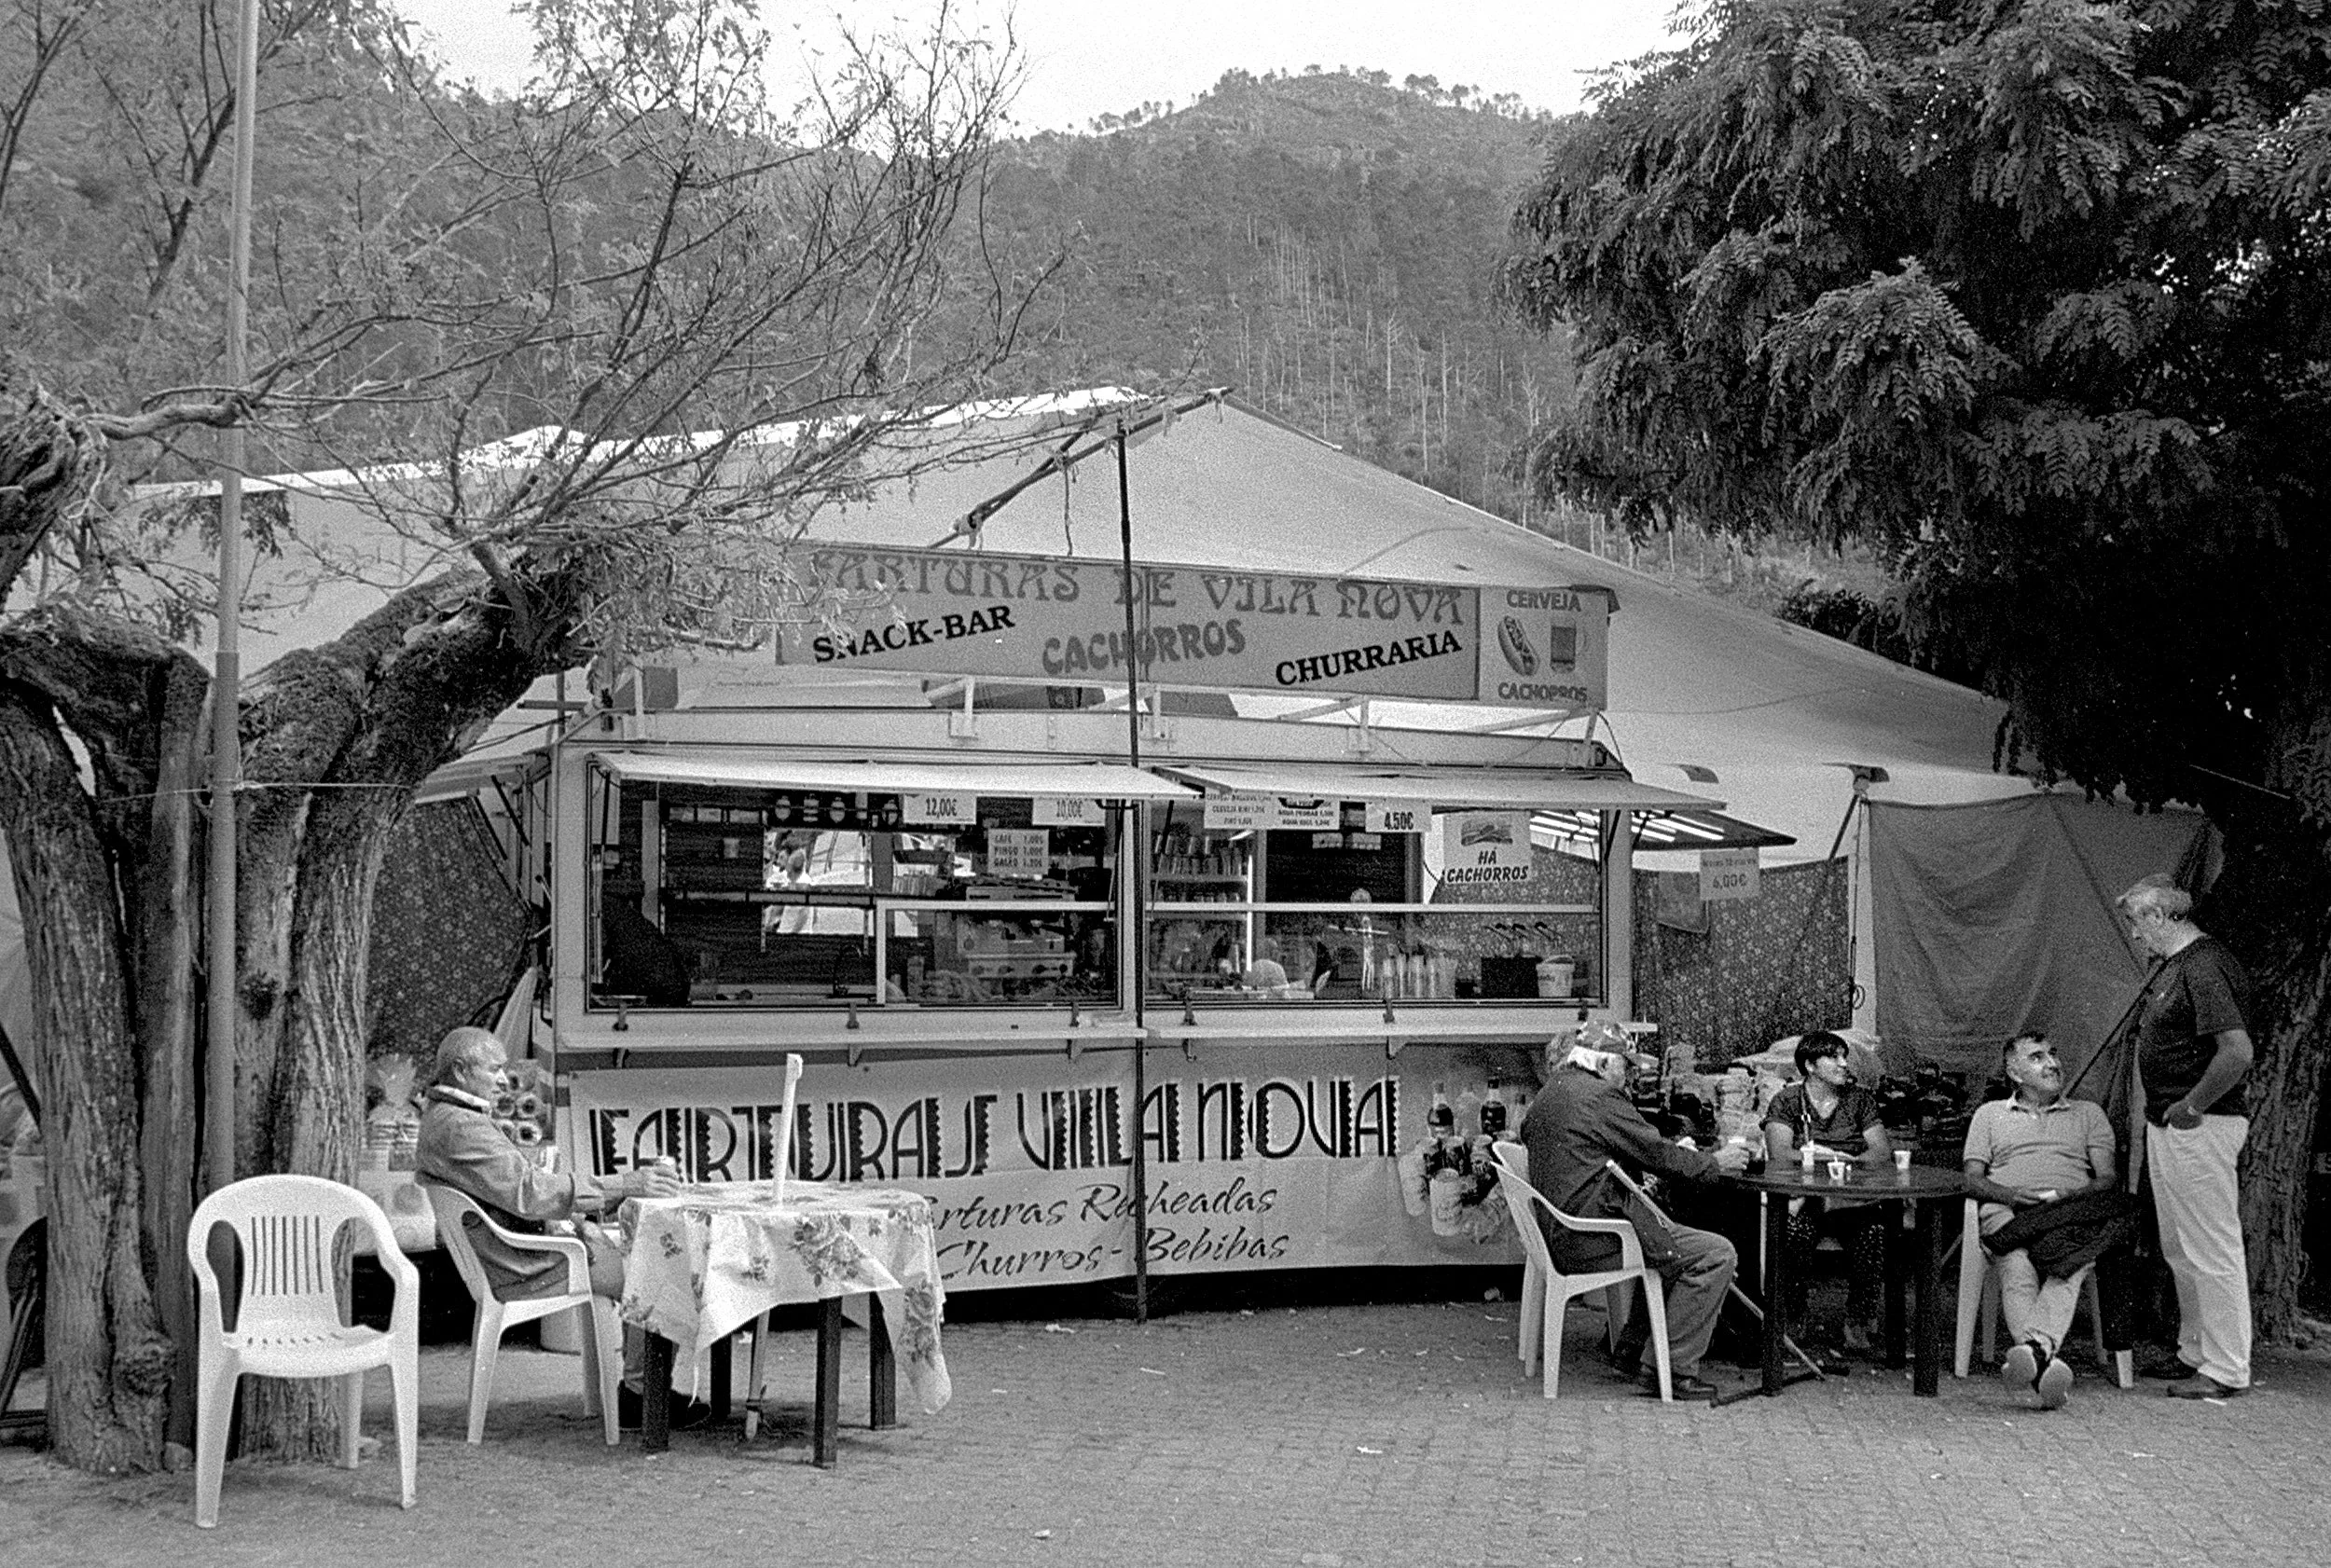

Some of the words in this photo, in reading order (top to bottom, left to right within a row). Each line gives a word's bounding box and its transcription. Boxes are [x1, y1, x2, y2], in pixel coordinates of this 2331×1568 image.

[1113, 567, 1177, 608] DE
[1200, 574, 1320, 616] VILA
[1336, 578, 1464, 626] NOVA
[1506, 589, 1582, 612] CERVEJA
[812, 604, 1016, 663] SNACK-BAR
[1041, 618, 1247, 675] CACHORROS
[1276, 629, 1463, 685] CHURRARIA
[926, 798, 958, 818] 12,00€
[1446, 865, 1529, 883] CACHORROS
[1478, 846, 1497, 865] HÁ
[1017, 1082, 1181, 1170] VILA
[1198, 1076, 1400, 1162] NOVA
[923, 1195, 1068, 1231] rturas
[1135, 1226, 1290, 1263] Bebibas
